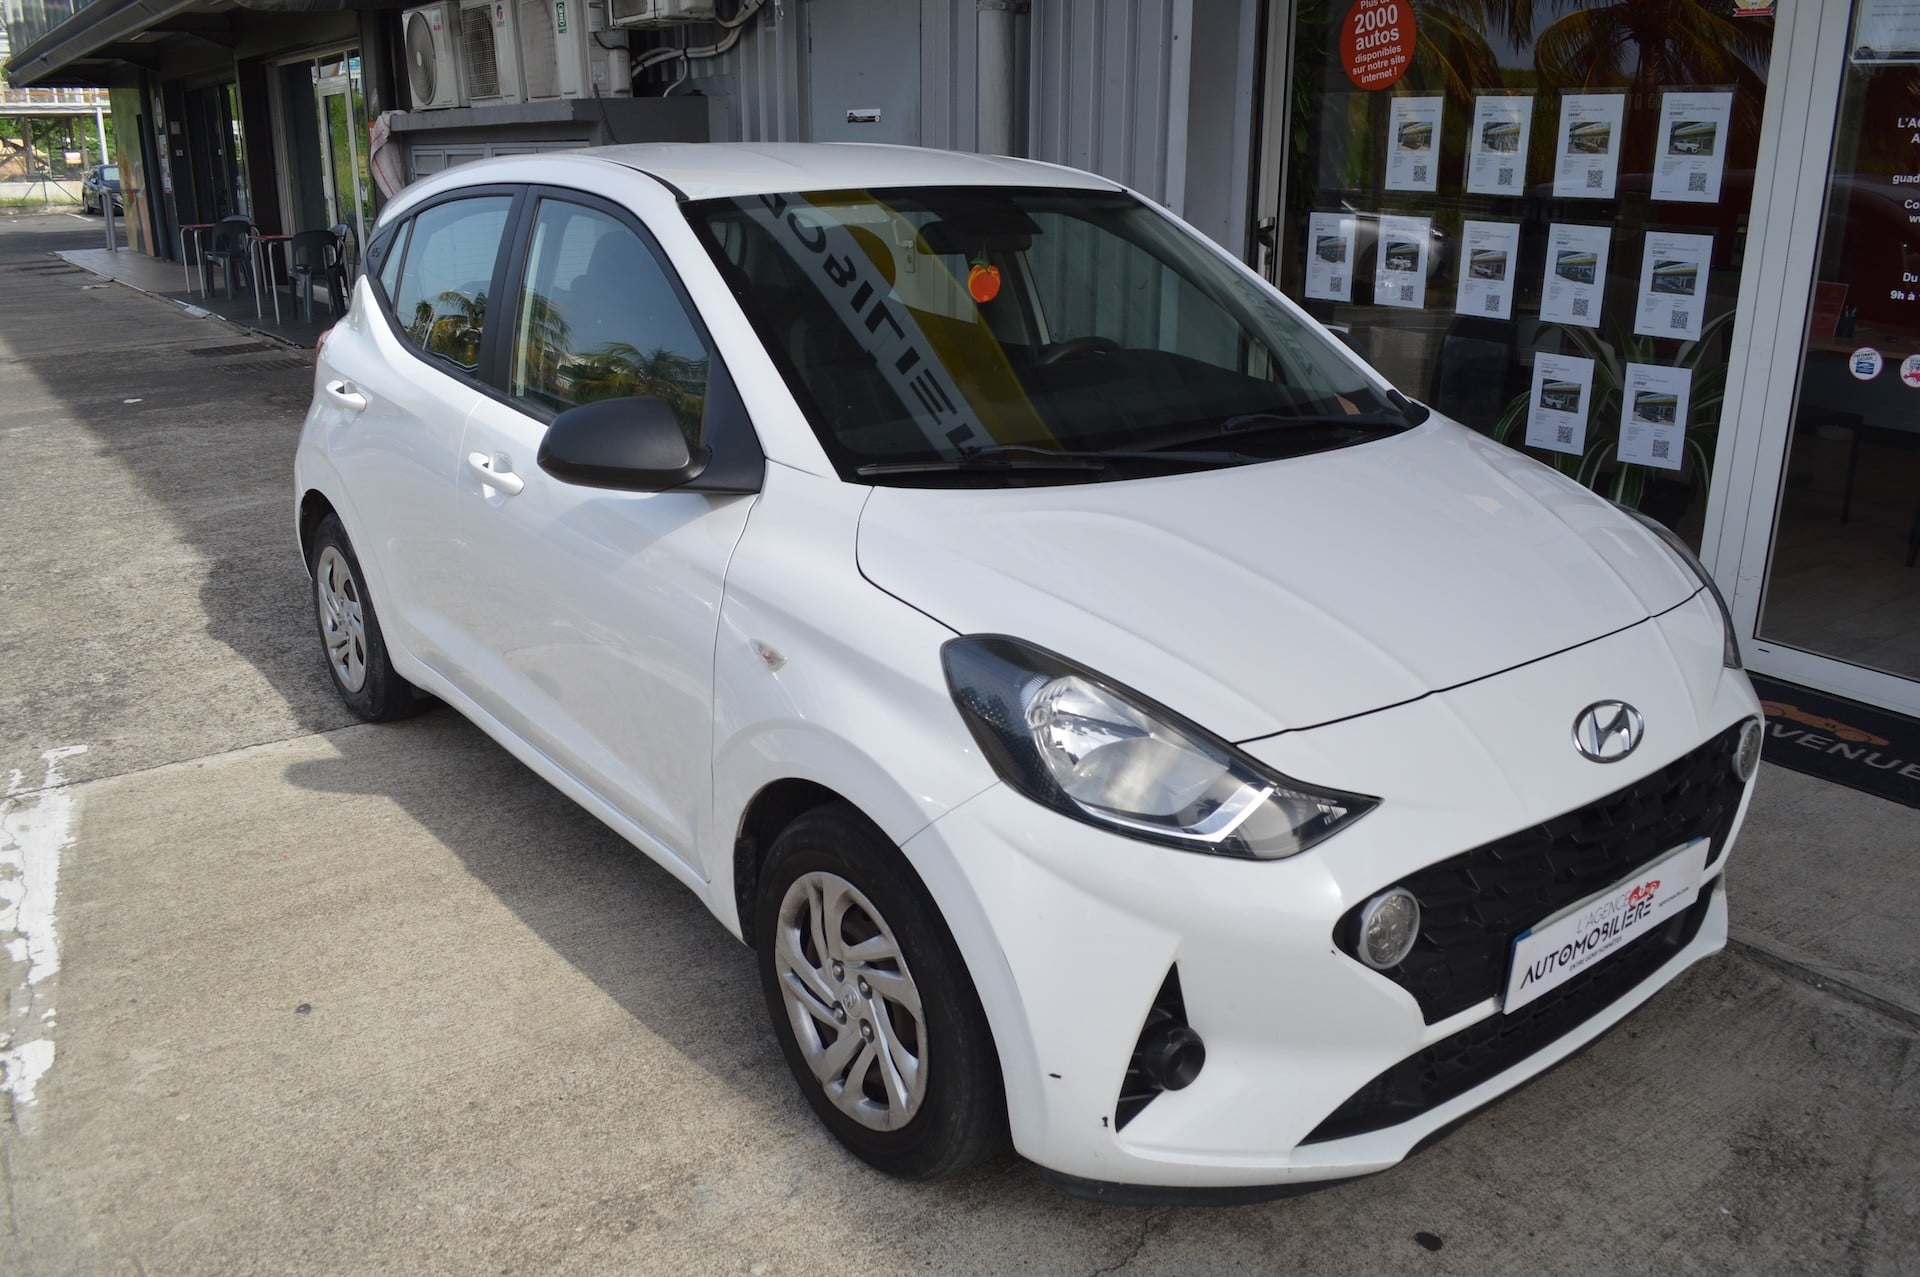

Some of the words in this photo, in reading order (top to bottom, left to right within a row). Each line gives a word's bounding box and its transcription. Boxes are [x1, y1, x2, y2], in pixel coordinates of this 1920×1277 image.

[1360, 0, 1379, 10] Plus
[1354, 4, 1398, 35] 2000
[1355, 28, 1400, 51] autos
[1354, 45, 1402, 63] disponibles
[1352, 66, 1366, 75] sur
[1367, 59, 1389, 71] notre
[1390, 55, 1406, 66] site
[1361, 68, 1393, 84] internet
[1902, 271, 1918, 283] Du
[1890, 289, 1905, 301] 9h
[1765, 720, 1920, 780] VENUE
